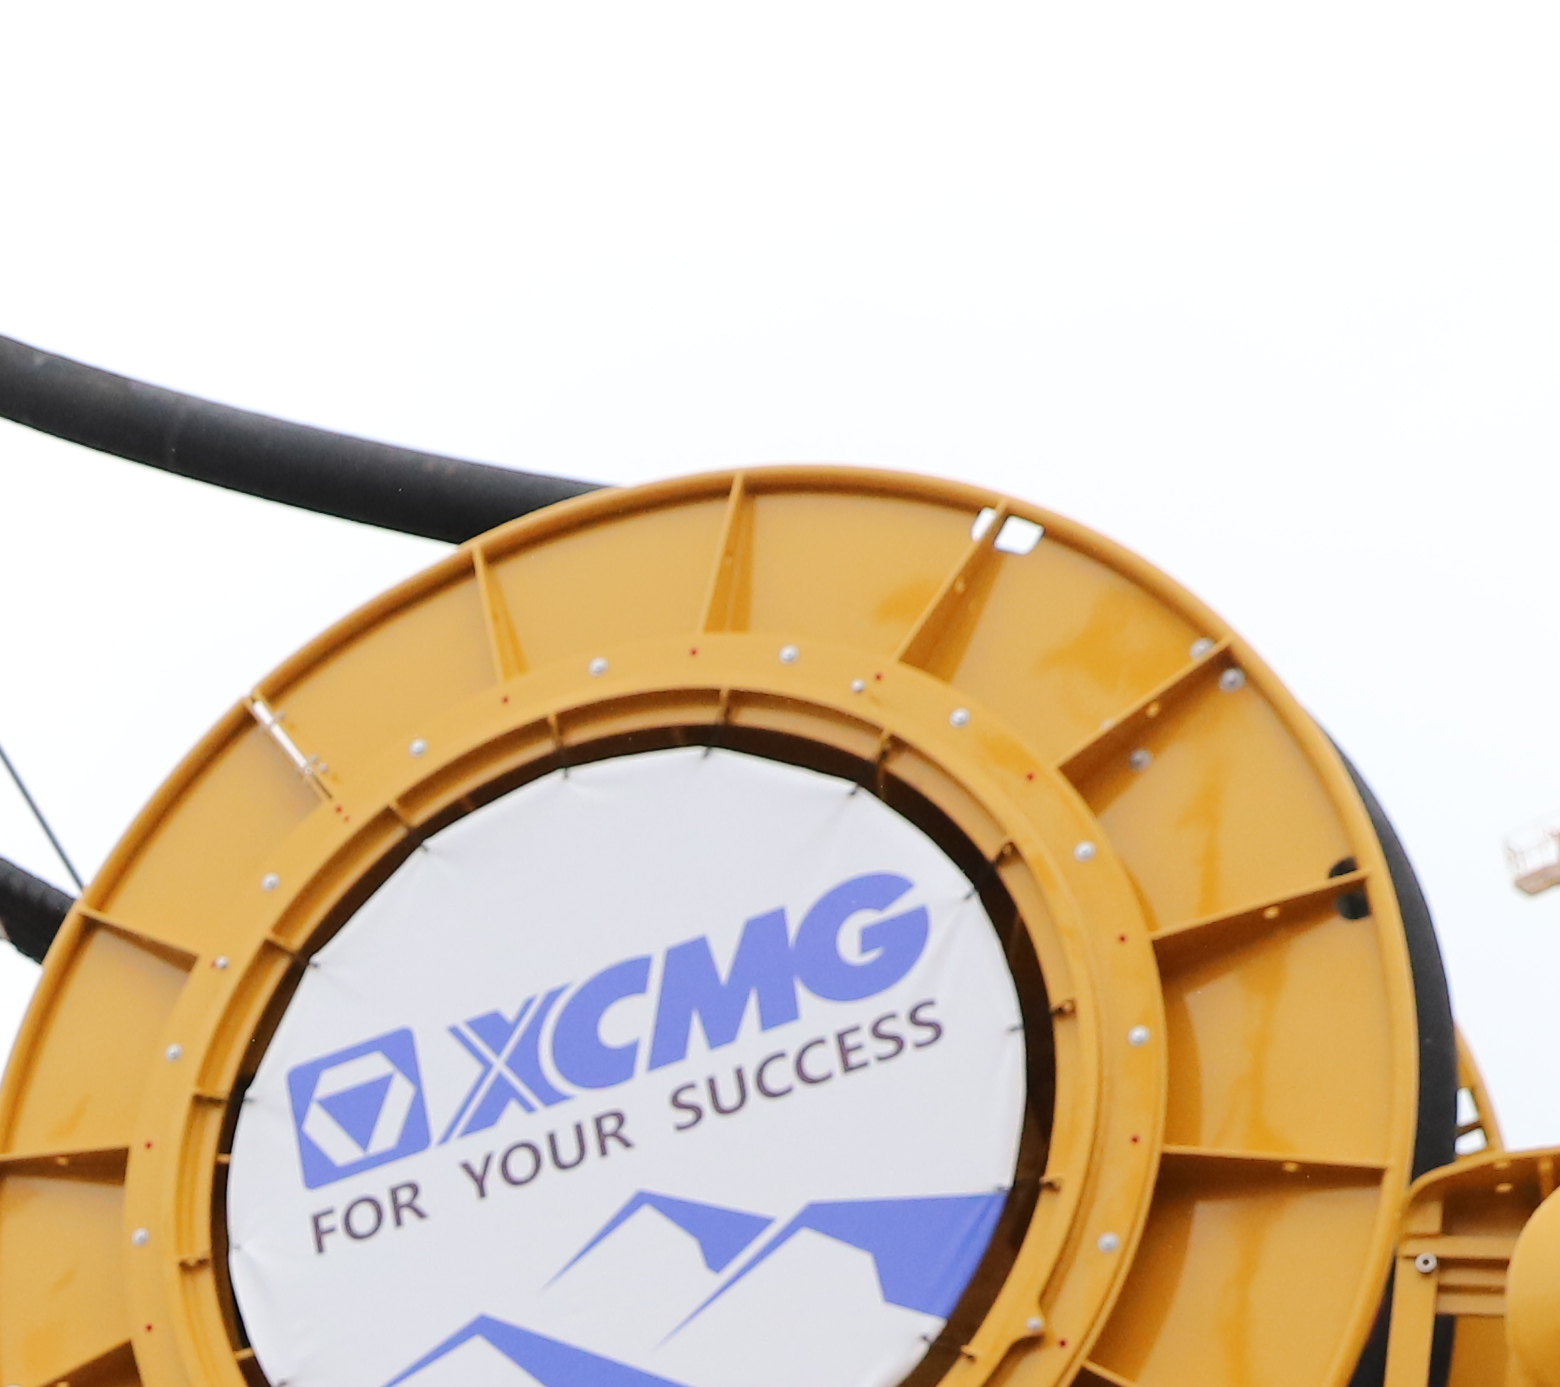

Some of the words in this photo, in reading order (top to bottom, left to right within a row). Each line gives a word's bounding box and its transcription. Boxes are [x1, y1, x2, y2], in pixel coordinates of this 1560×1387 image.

[310, 1180, 428, 1255] FOR
[460, 1110, 633, 1201] YOUR
[669, 1000, 944, 1133] SUCCESS
[437, 872, 930, 1145] XCMG
